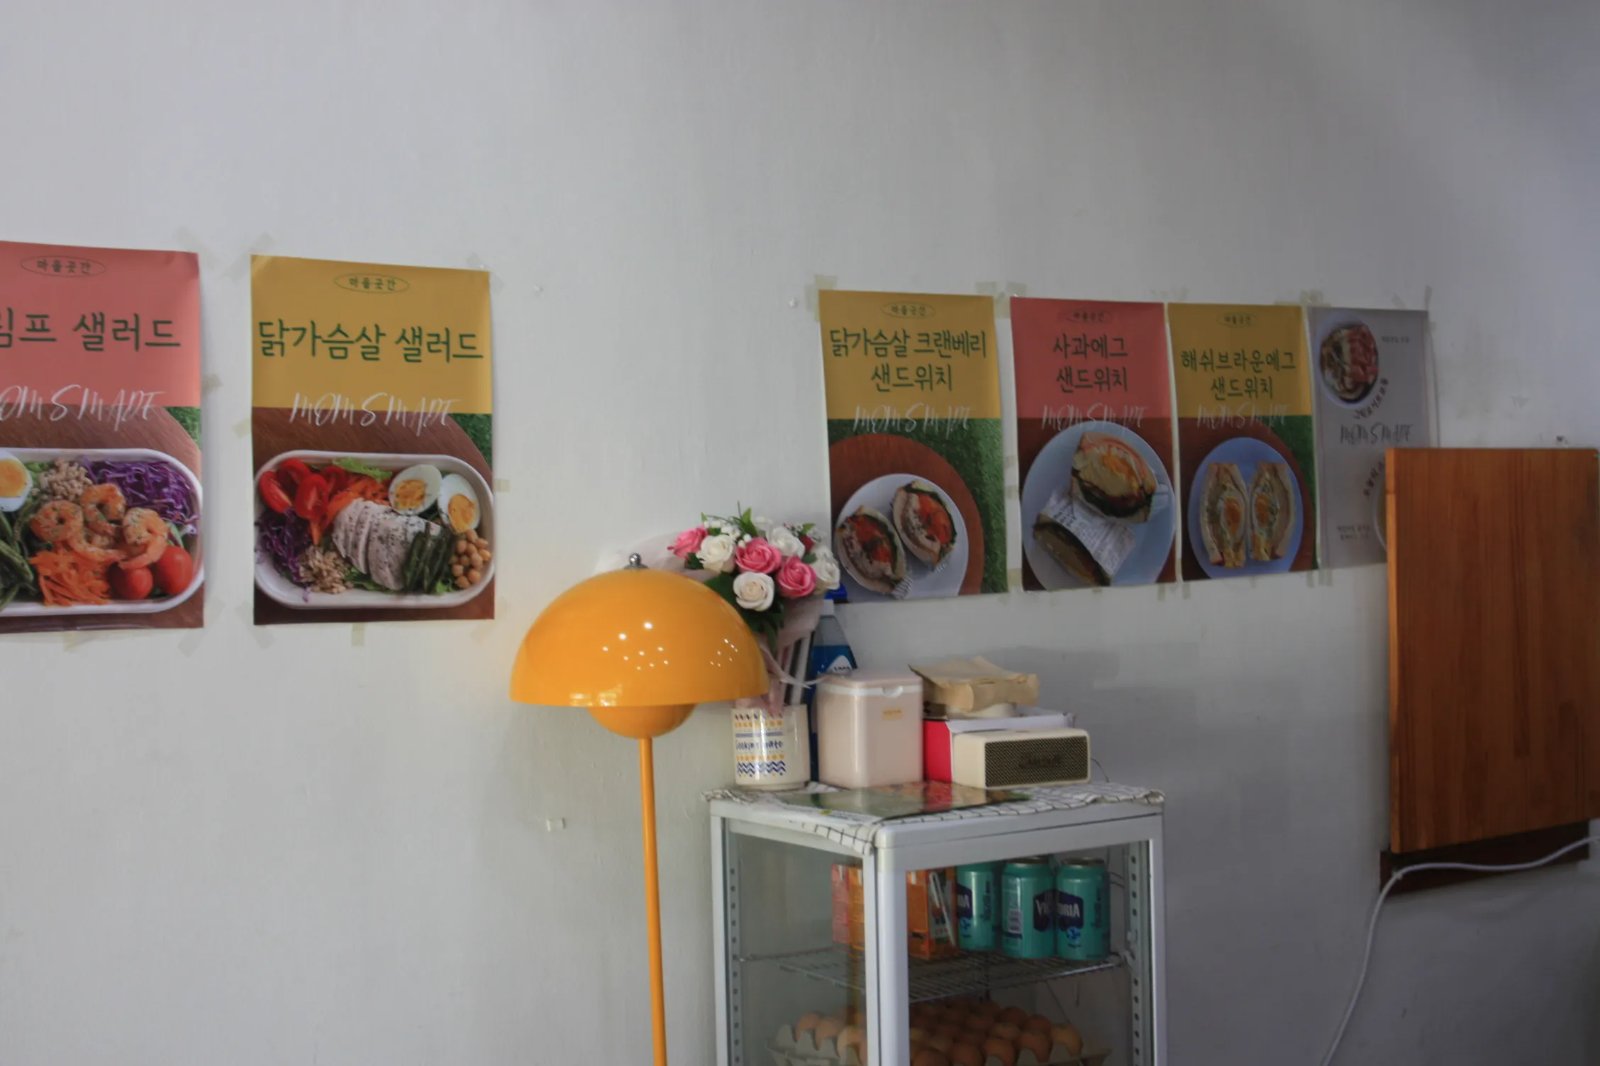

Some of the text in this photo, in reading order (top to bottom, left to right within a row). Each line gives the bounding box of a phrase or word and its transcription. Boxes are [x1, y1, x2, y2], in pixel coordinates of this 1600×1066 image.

[73, 311, 181, 352] 샐러드
[258, 318, 484, 363] 닭가슴살 샐러드
[829, 327, 987, 359] 닭가슴살 크랜베리
[1053, 333, 1129, 359] 사과에그
[1181, 348, 1296, 373] 해쉬브라운에그
[870, 363, 953, 393] 샌드위치
[1056, 365, 1129, 394] 샌드위치
[1211, 376, 1273, 401] 샌드위치
